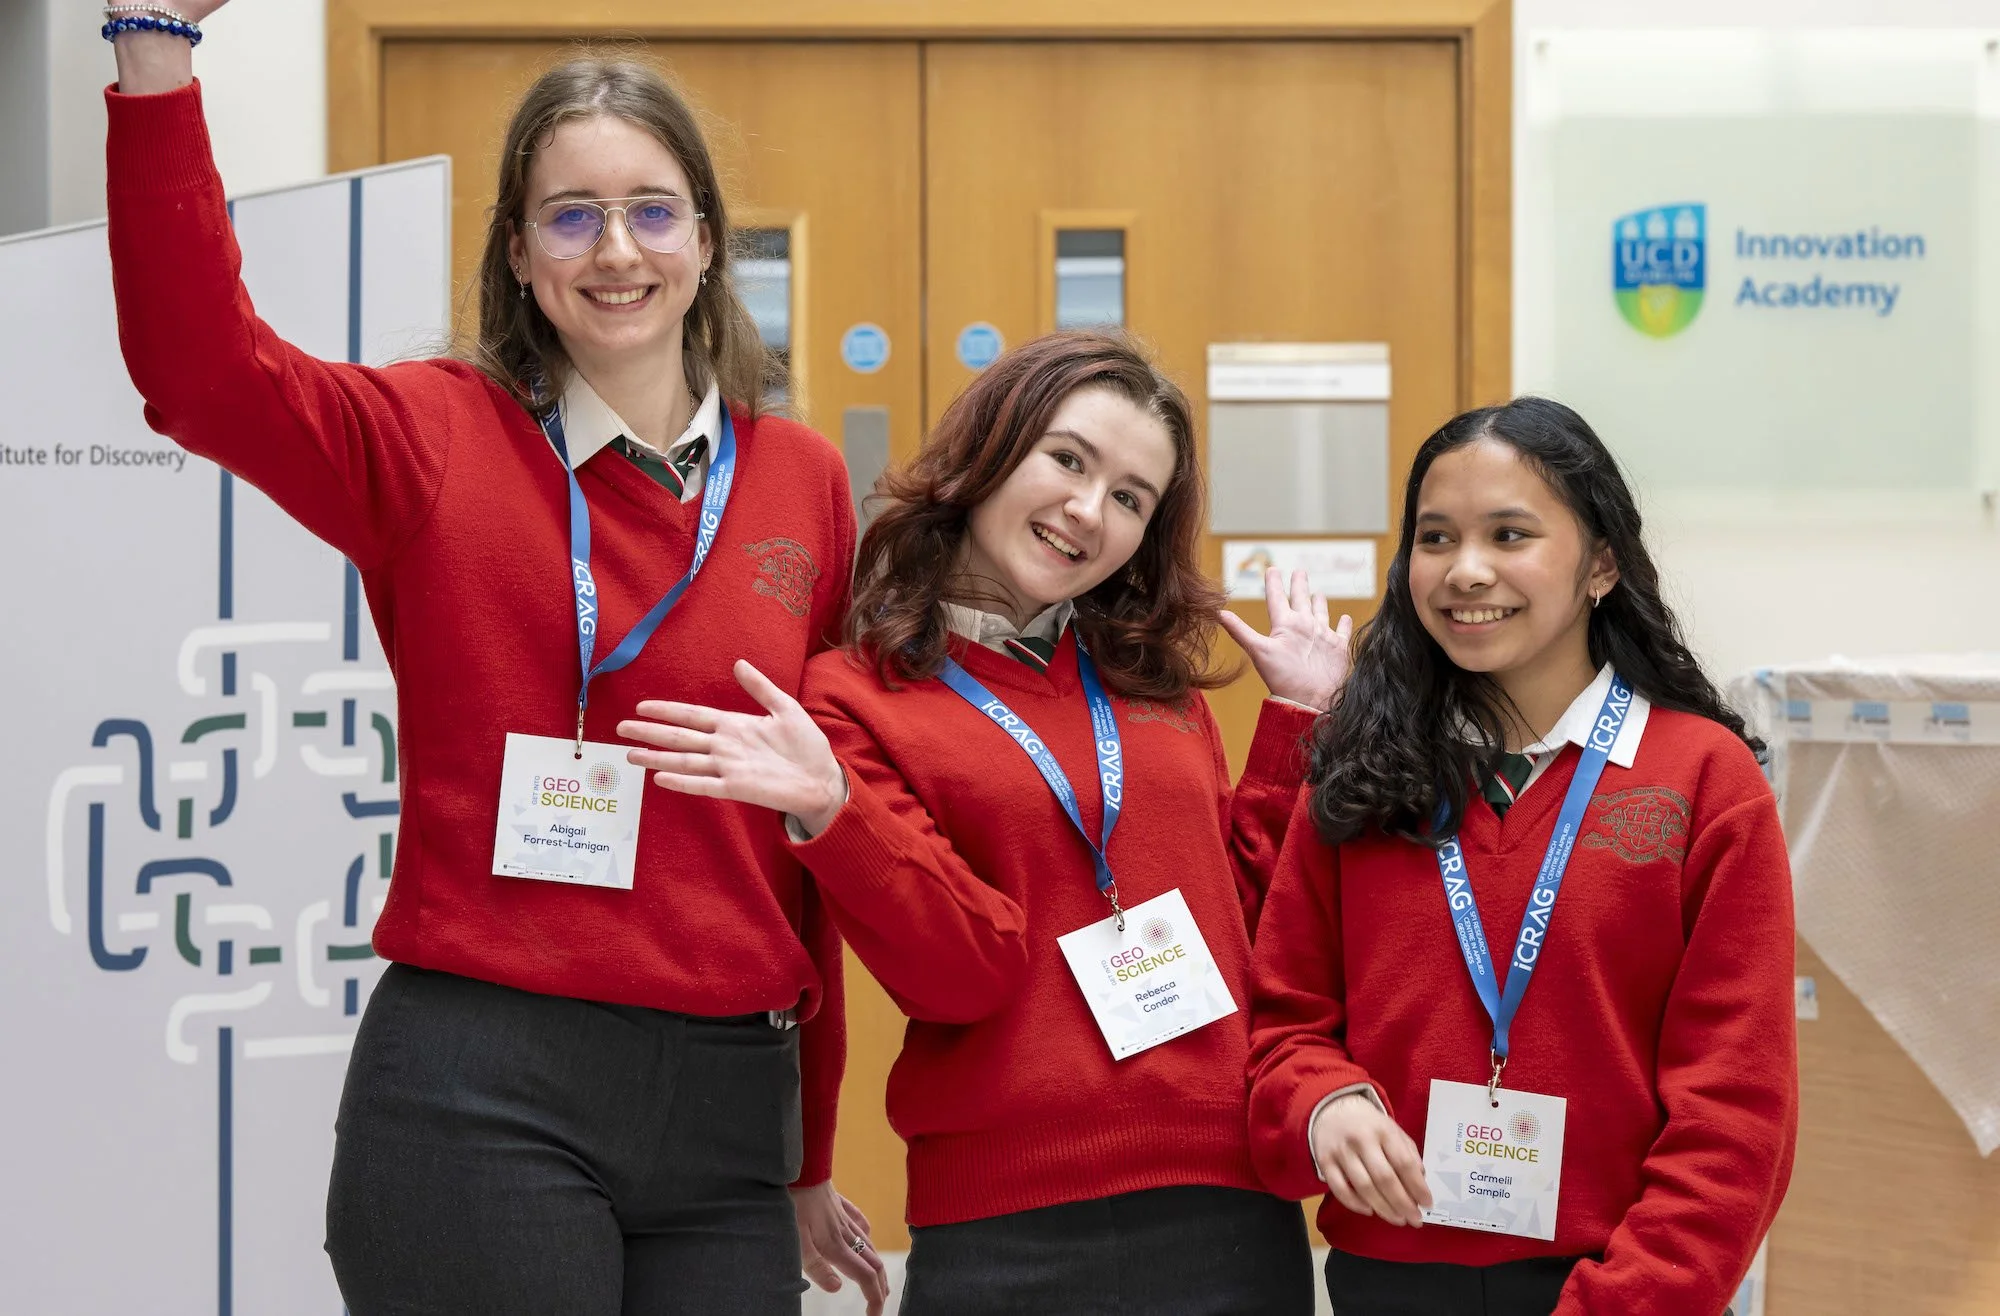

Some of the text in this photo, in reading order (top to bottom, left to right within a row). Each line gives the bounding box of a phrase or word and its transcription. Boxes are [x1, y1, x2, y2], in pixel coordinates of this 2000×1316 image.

[1621, 240, 1699, 270] UCD
[1736, 228, 1925, 259] Innovation
[1736, 275, 1899, 317] Academy
[55, 443, 83, 466] for
[90, 444, 187, 473] Discovery
[690, 510, 718, 582] iCRAG
[573, 557, 596, 636] iCRAG
[981, 700, 1043, 755] iCRAG
[1589, 685, 1631, 753] iCRAG
[543, 777, 580, 793] GEO
[1098, 740, 1121, 811] iCRAG
[541, 793, 618, 813] SCIENCE
[524, 834, 610, 854] Forrest-Lanigan
[550, 824, 586, 838] Abigail
[1463, 916, 1476, 942] CENTRE
[1472, 921, 1487, 955] RESEARCH
[1513, 888, 1555, 972] iCRAG
[1110, 947, 1144, 968] GEO
[1116, 944, 1186, 982] SCIENCE
[1135, 980, 1176, 1002] Rebecca
[1143, 993, 1180, 1013] Condon
[1466, 1124, 1502, 1141] GEO
[1464, 1140, 1539, 1163] SCIENCE
[1468, 1185, 1511, 1199] Sampilo
[1470, 1171, 1512, 1185] Carmelil
